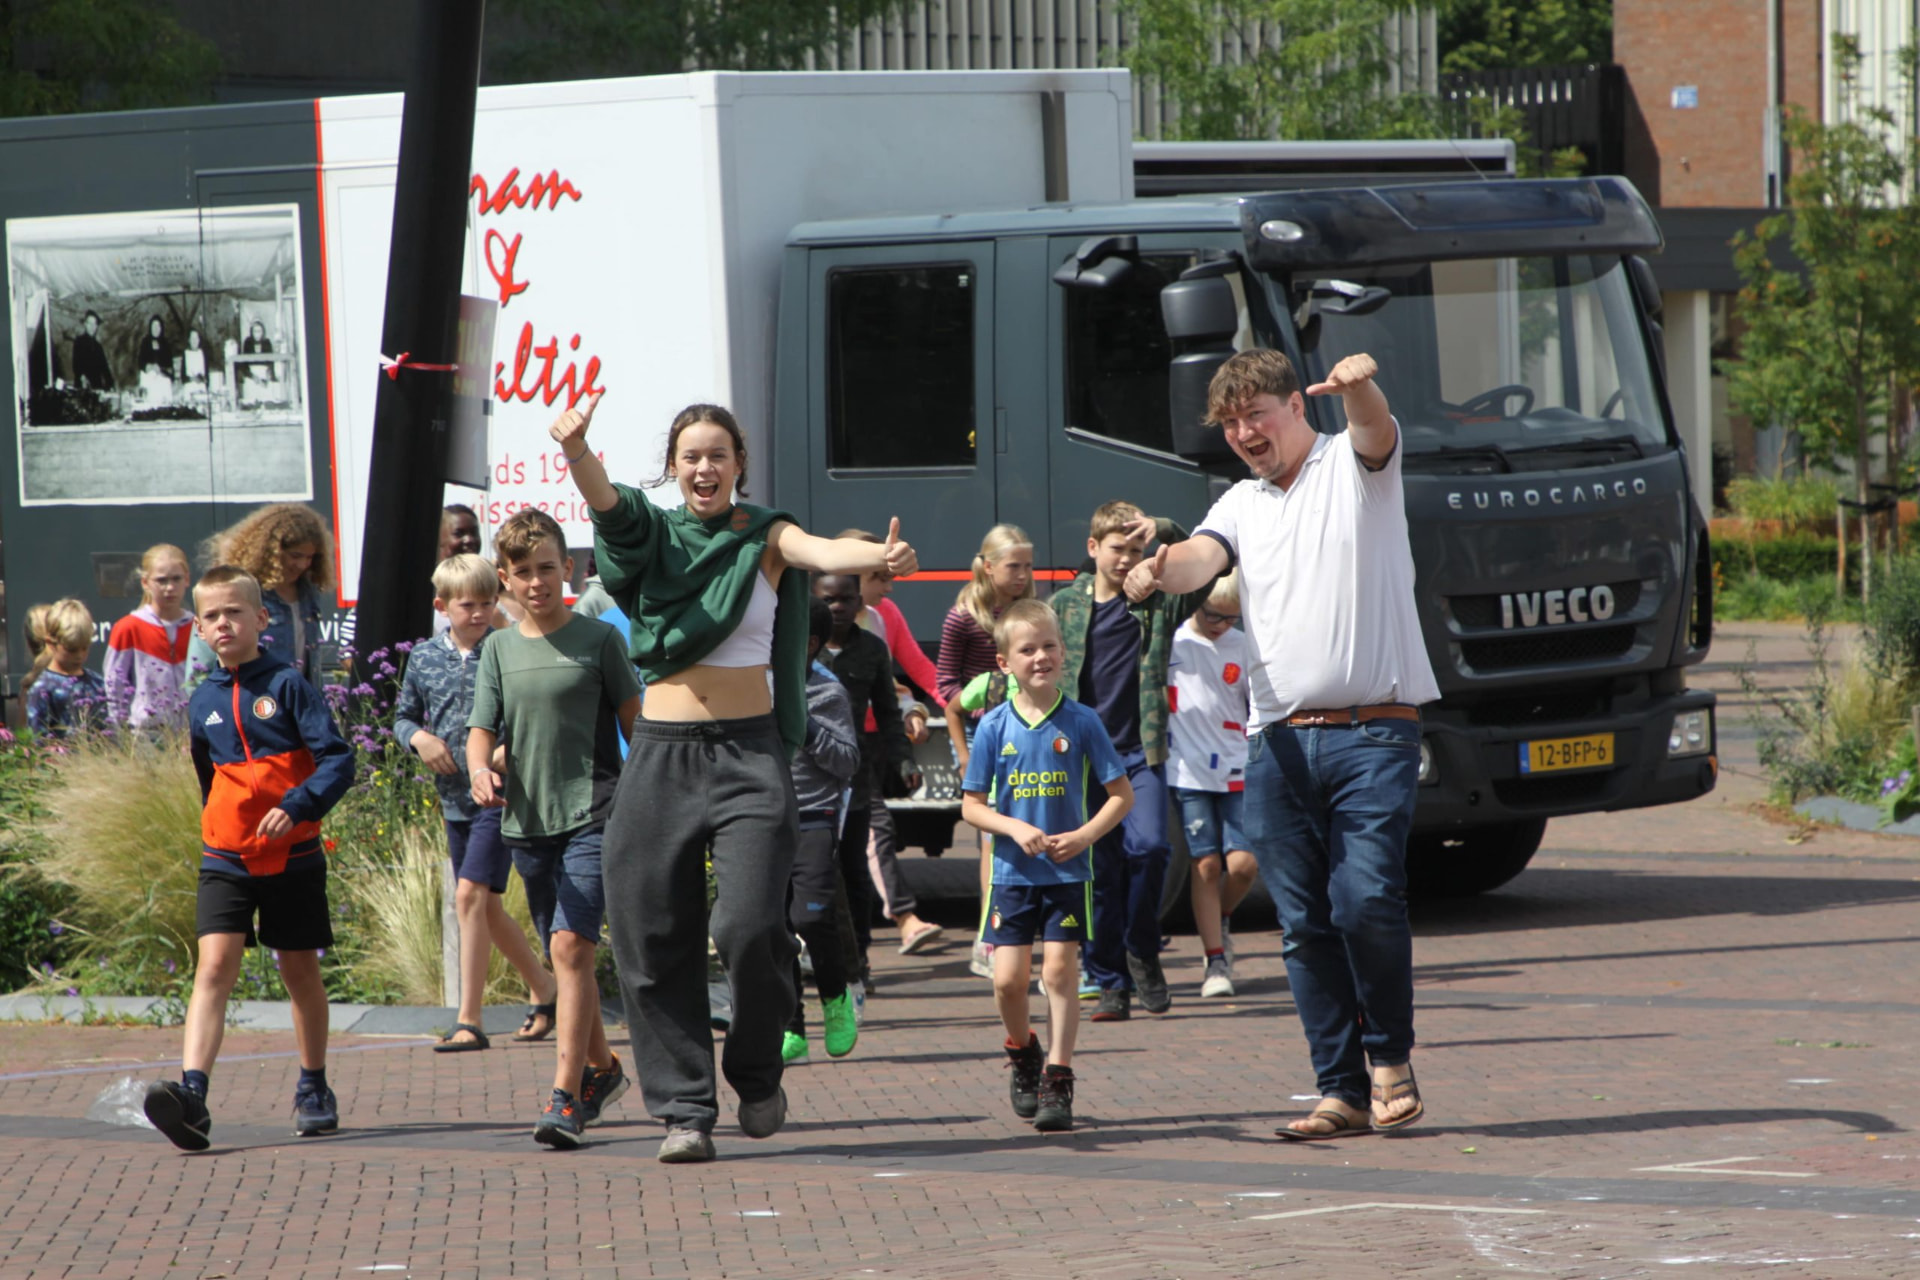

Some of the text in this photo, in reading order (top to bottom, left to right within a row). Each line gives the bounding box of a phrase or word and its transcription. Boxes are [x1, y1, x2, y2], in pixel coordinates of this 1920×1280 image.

[469, 167, 582, 216] ram
[484, 228, 530, 308] &
[1448, 478, 1647, 510] EUROCARGO
[1501, 585, 1615, 629] IVECO
[1538, 740, 1607, 767] 12-BFP-6
[1008, 768, 1068, 786] droom
[1013, 784, 1065, 801] parken
